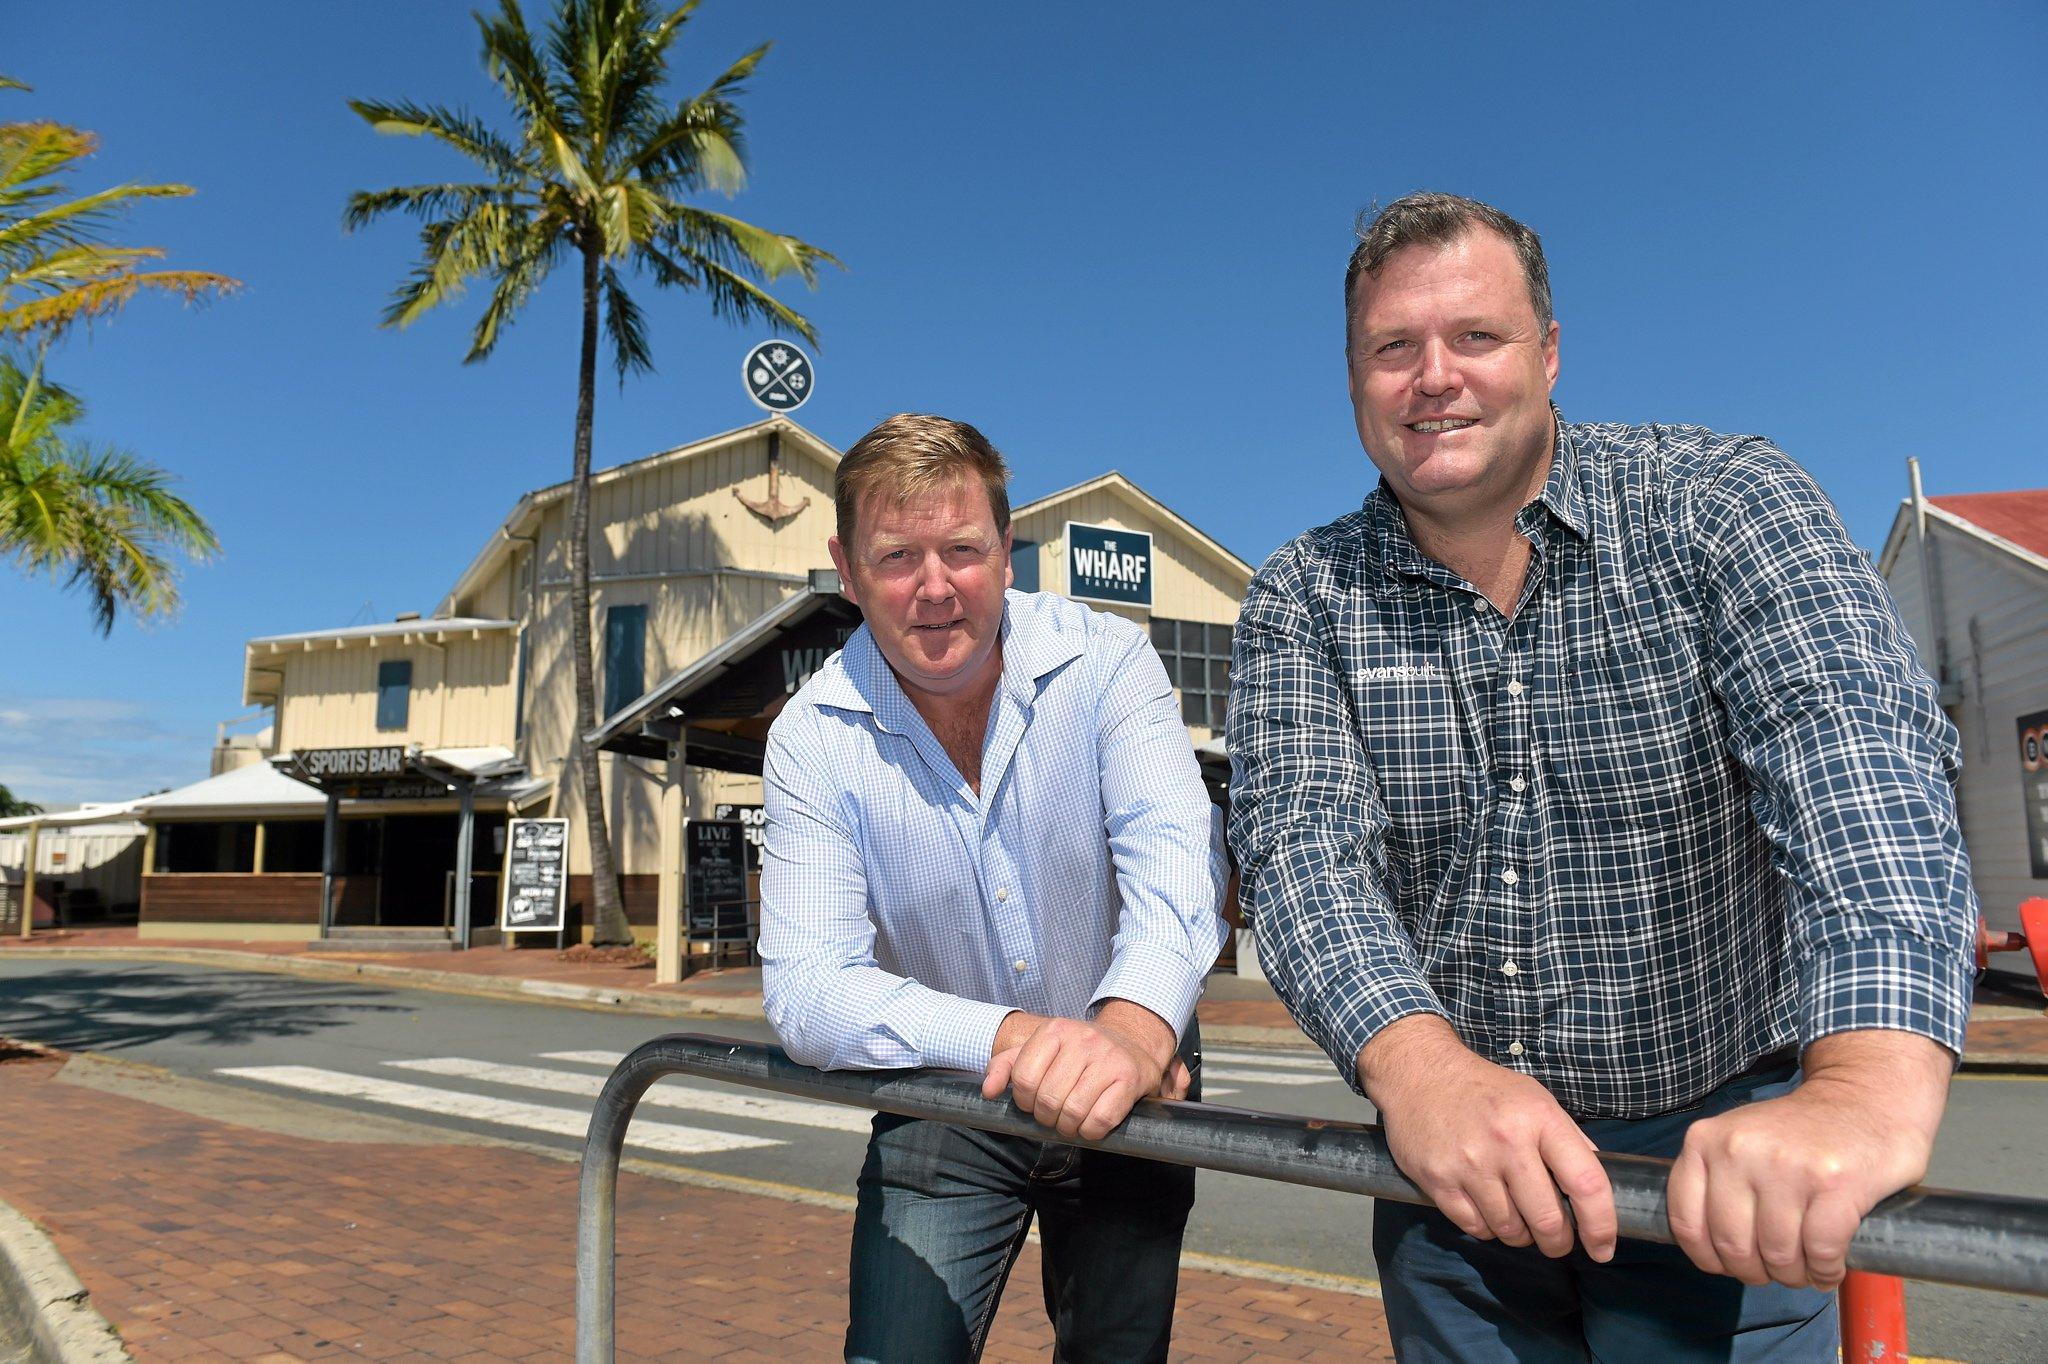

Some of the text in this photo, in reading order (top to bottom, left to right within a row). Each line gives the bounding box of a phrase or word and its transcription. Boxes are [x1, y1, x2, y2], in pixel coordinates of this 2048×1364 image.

[1104, 540, 1117, 551] THE
[1074, 547, 1147, 583] WHARF
[1085, 578, 1137, 591] TAVERN
[1356, 662, 1436, 679] evansbuilt
[309, 748, 401, 774] SPORTS BAR
[698, 826, 731, 840] LIVE
